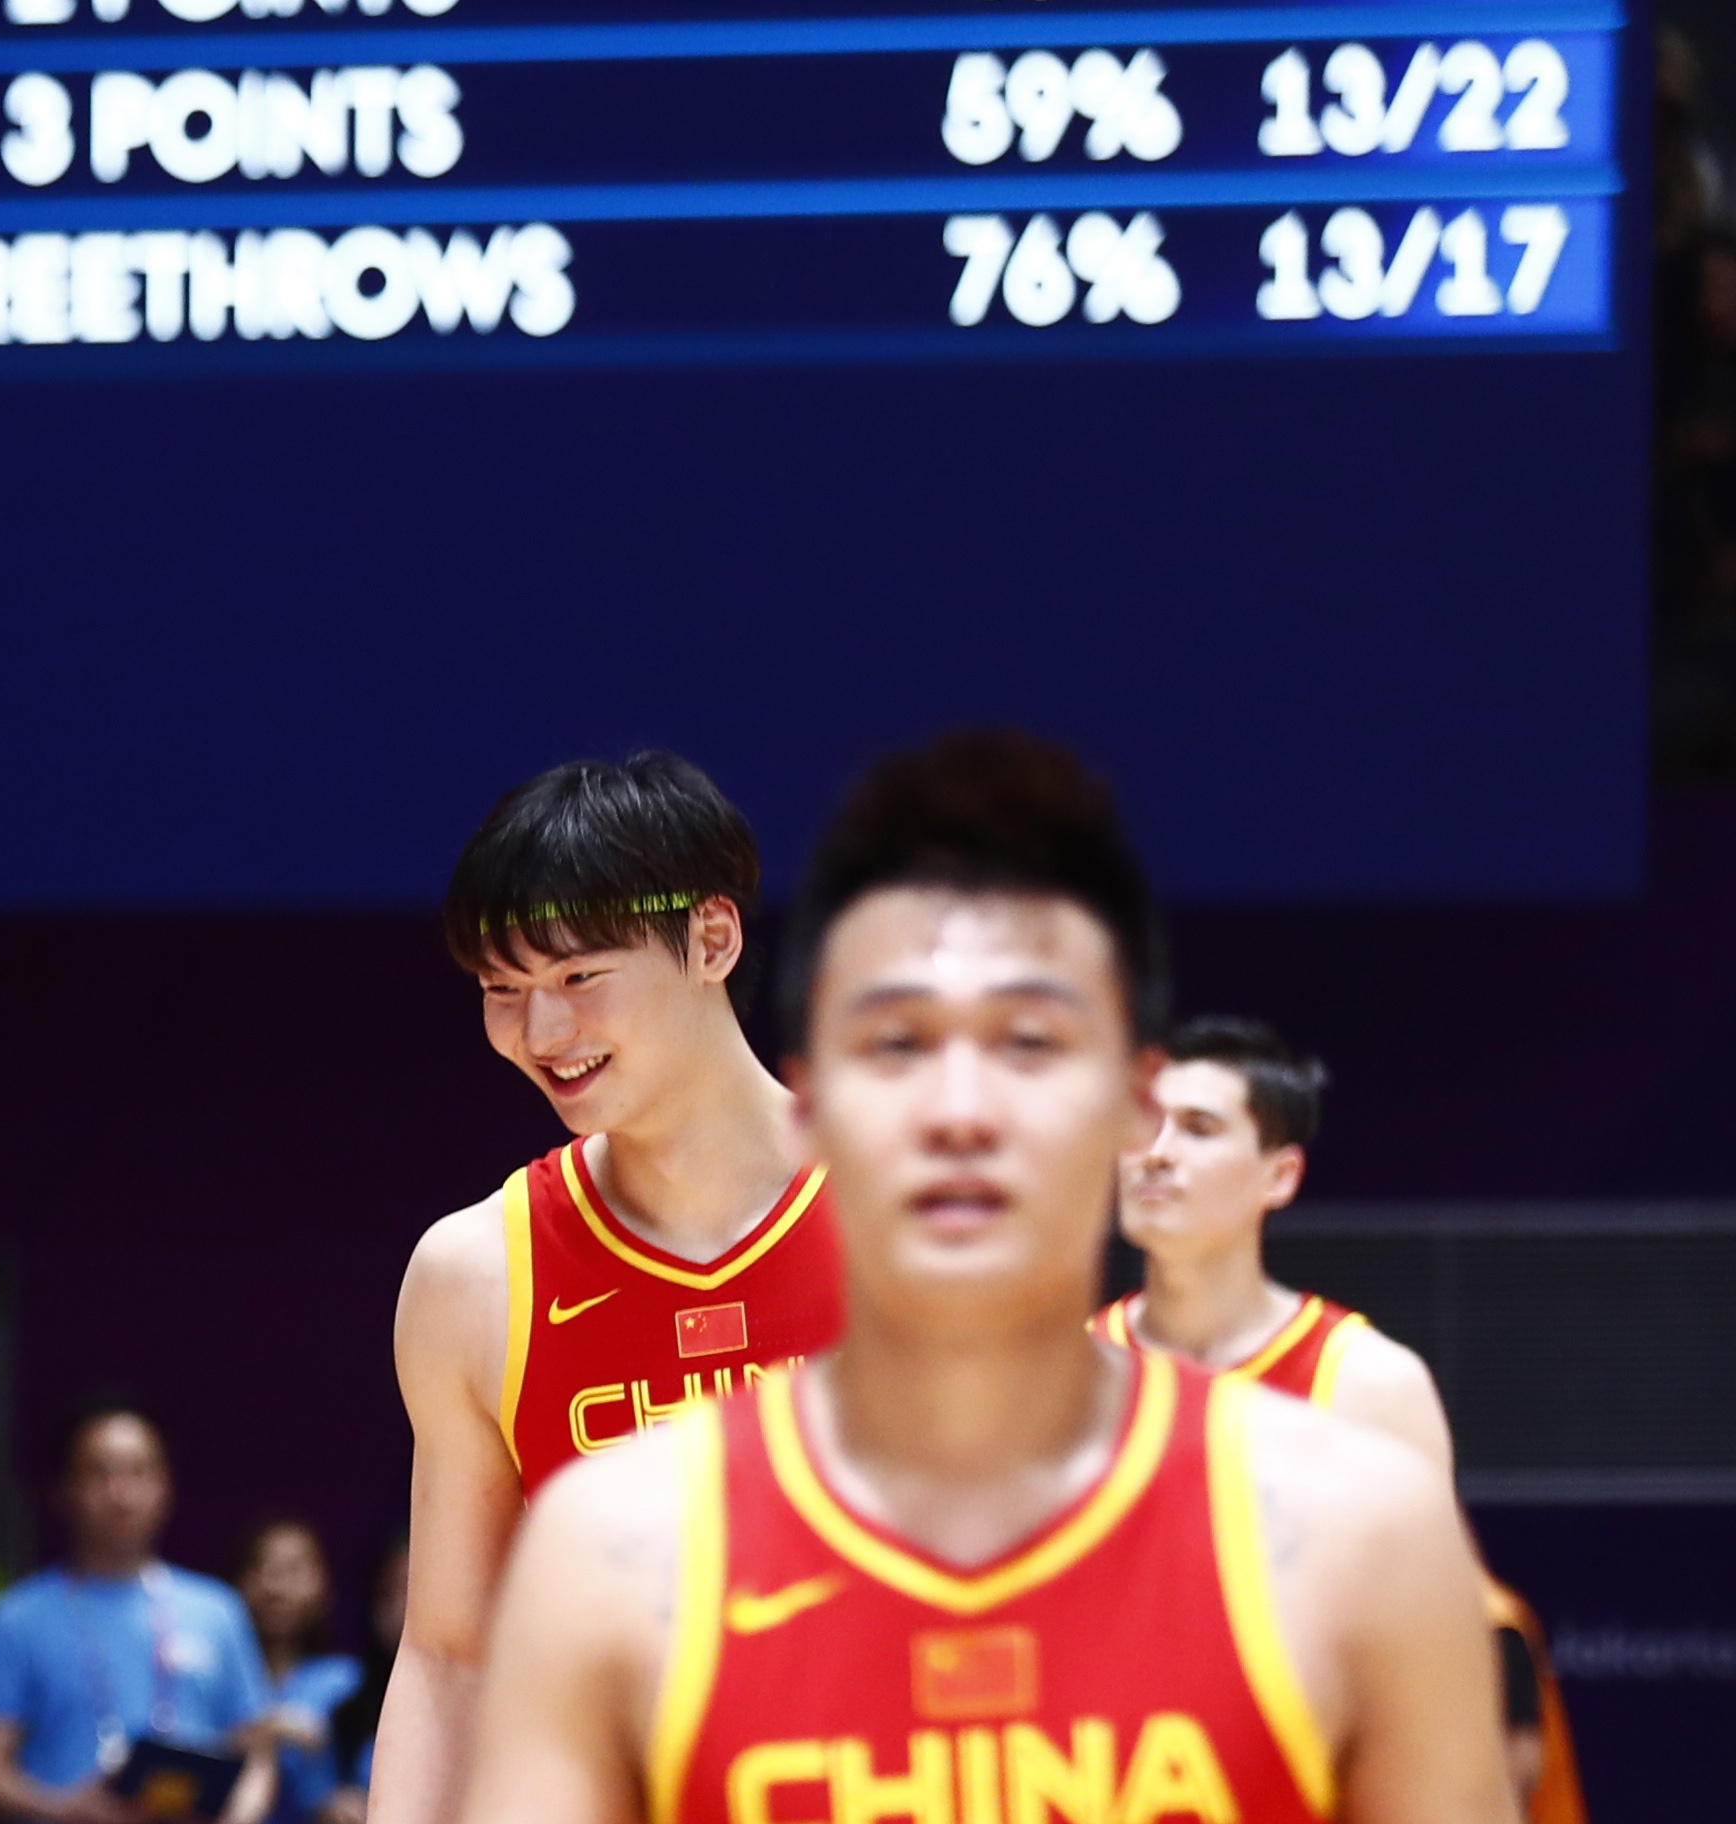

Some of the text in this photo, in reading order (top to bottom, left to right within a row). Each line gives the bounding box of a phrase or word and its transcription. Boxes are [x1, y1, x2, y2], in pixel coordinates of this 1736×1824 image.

[1, 72, 75, 187] 3
[90, 64, 464, 183] POINTS
[941, 48, 1183, 165] 59%
[1258, 40, 1569, 156] 13/22
[942, 211, 1182, 327] 76%
[1256, 205, 1569, 320] 13/17
